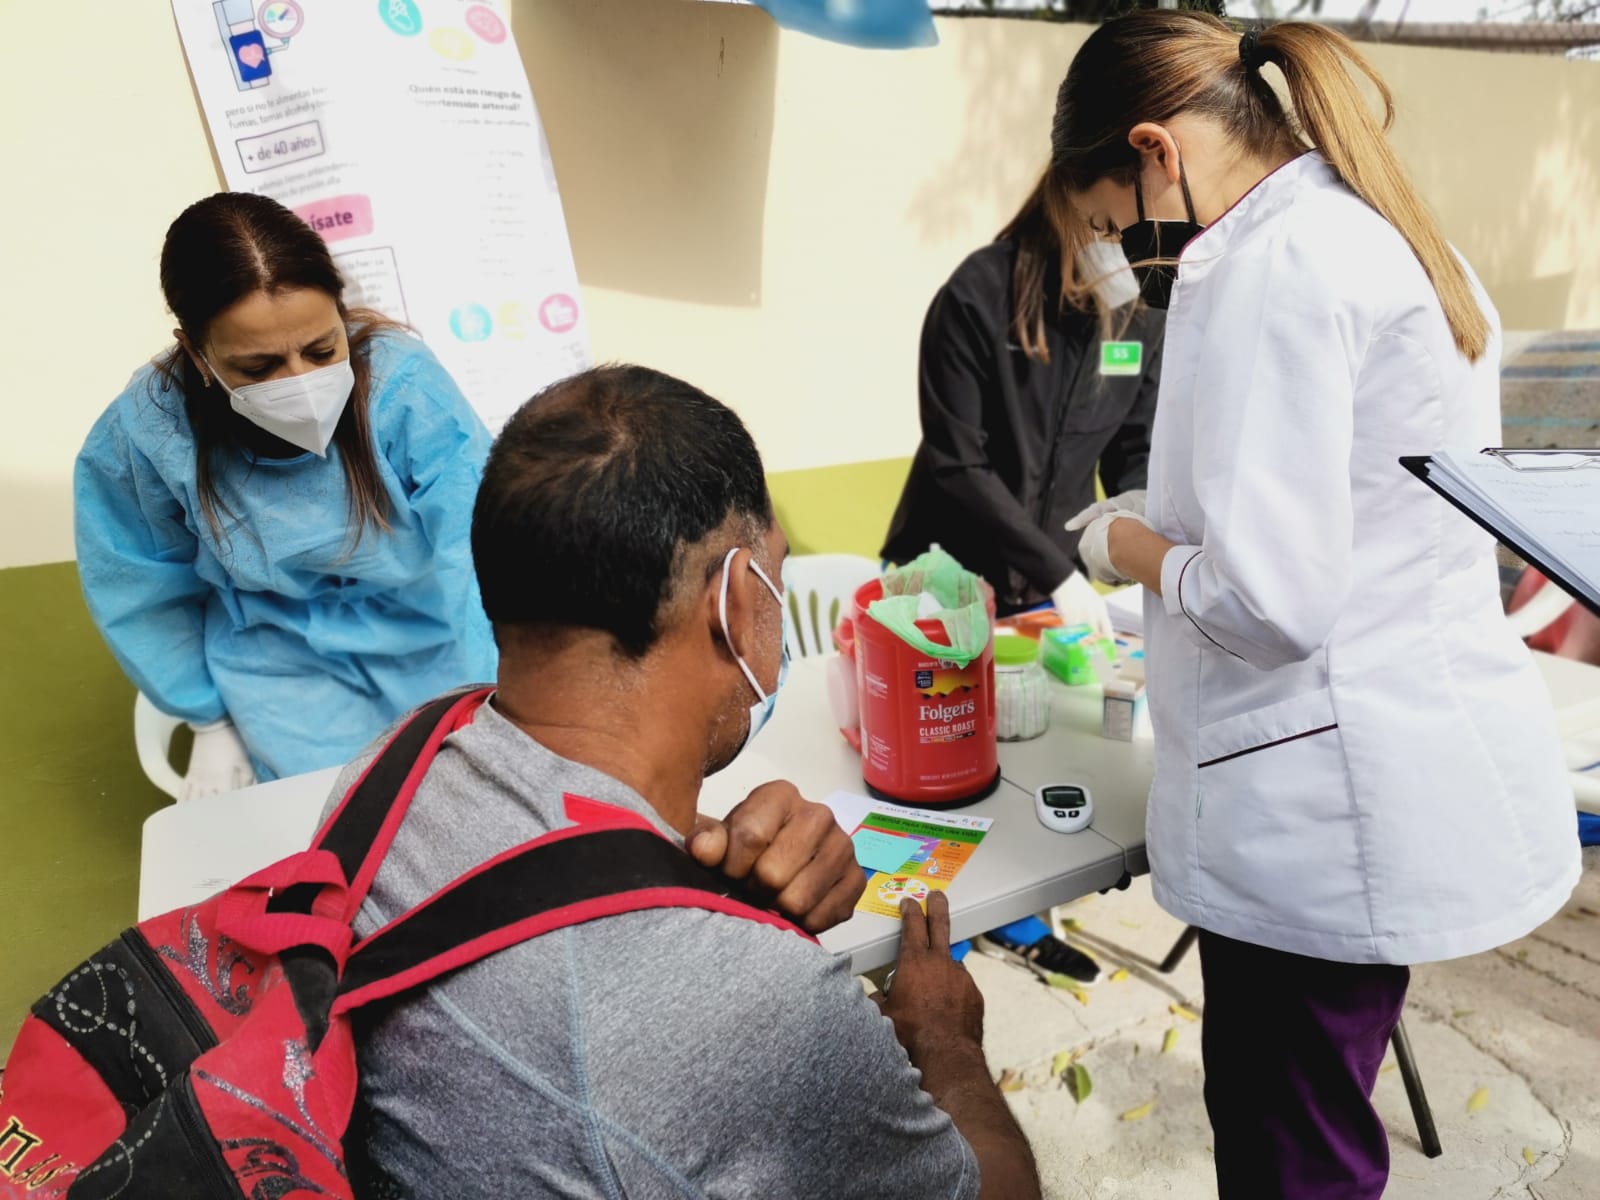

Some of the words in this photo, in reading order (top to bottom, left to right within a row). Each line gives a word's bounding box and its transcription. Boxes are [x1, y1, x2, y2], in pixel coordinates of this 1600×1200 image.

[257, 146, 272, 161] de
[273, 140, 288, 156] 40
[289, 135, 317, 152] años
[310, 211, 353, 232] ísate
[919, 700, 975, 723] Folgers
[919, 725, 951, 737] CLASSIC
[952, 719, 976, 732] ROAST
